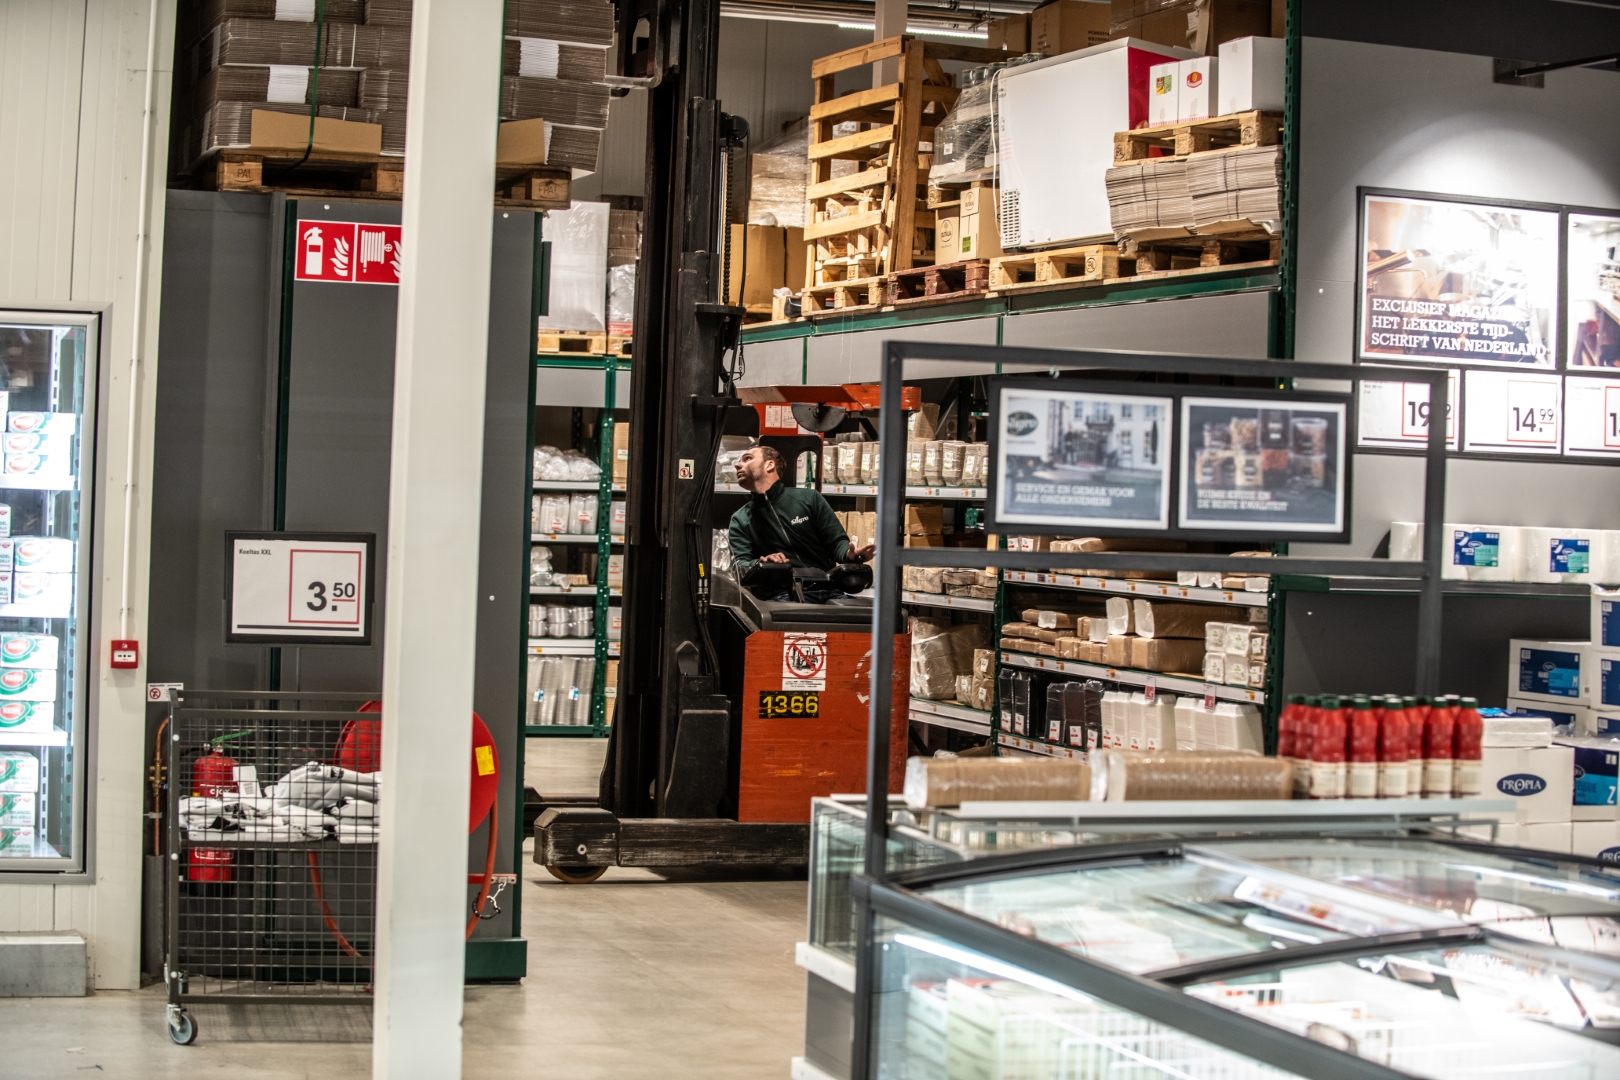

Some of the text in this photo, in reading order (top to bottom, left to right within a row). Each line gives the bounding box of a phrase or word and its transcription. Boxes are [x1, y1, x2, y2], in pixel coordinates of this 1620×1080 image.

[1372, 298, 1446, 316] EXCLUSIEF
[1372, 315, 1514, 340] HET LEKKERSTE TIJD-
[1371, 332, 1547, 356] SCHRIFT VAN NEDERLAND
[1512, 406, 1555, 433] 14.99
[1609, 412, 1620, 438] 1
[306, 581, 356, 612] 3.50
[762, 695, 819, 714] 1366
[1502, 778, 1542, 793] PROPIA
[1606, 785, 1617, 805] Z
